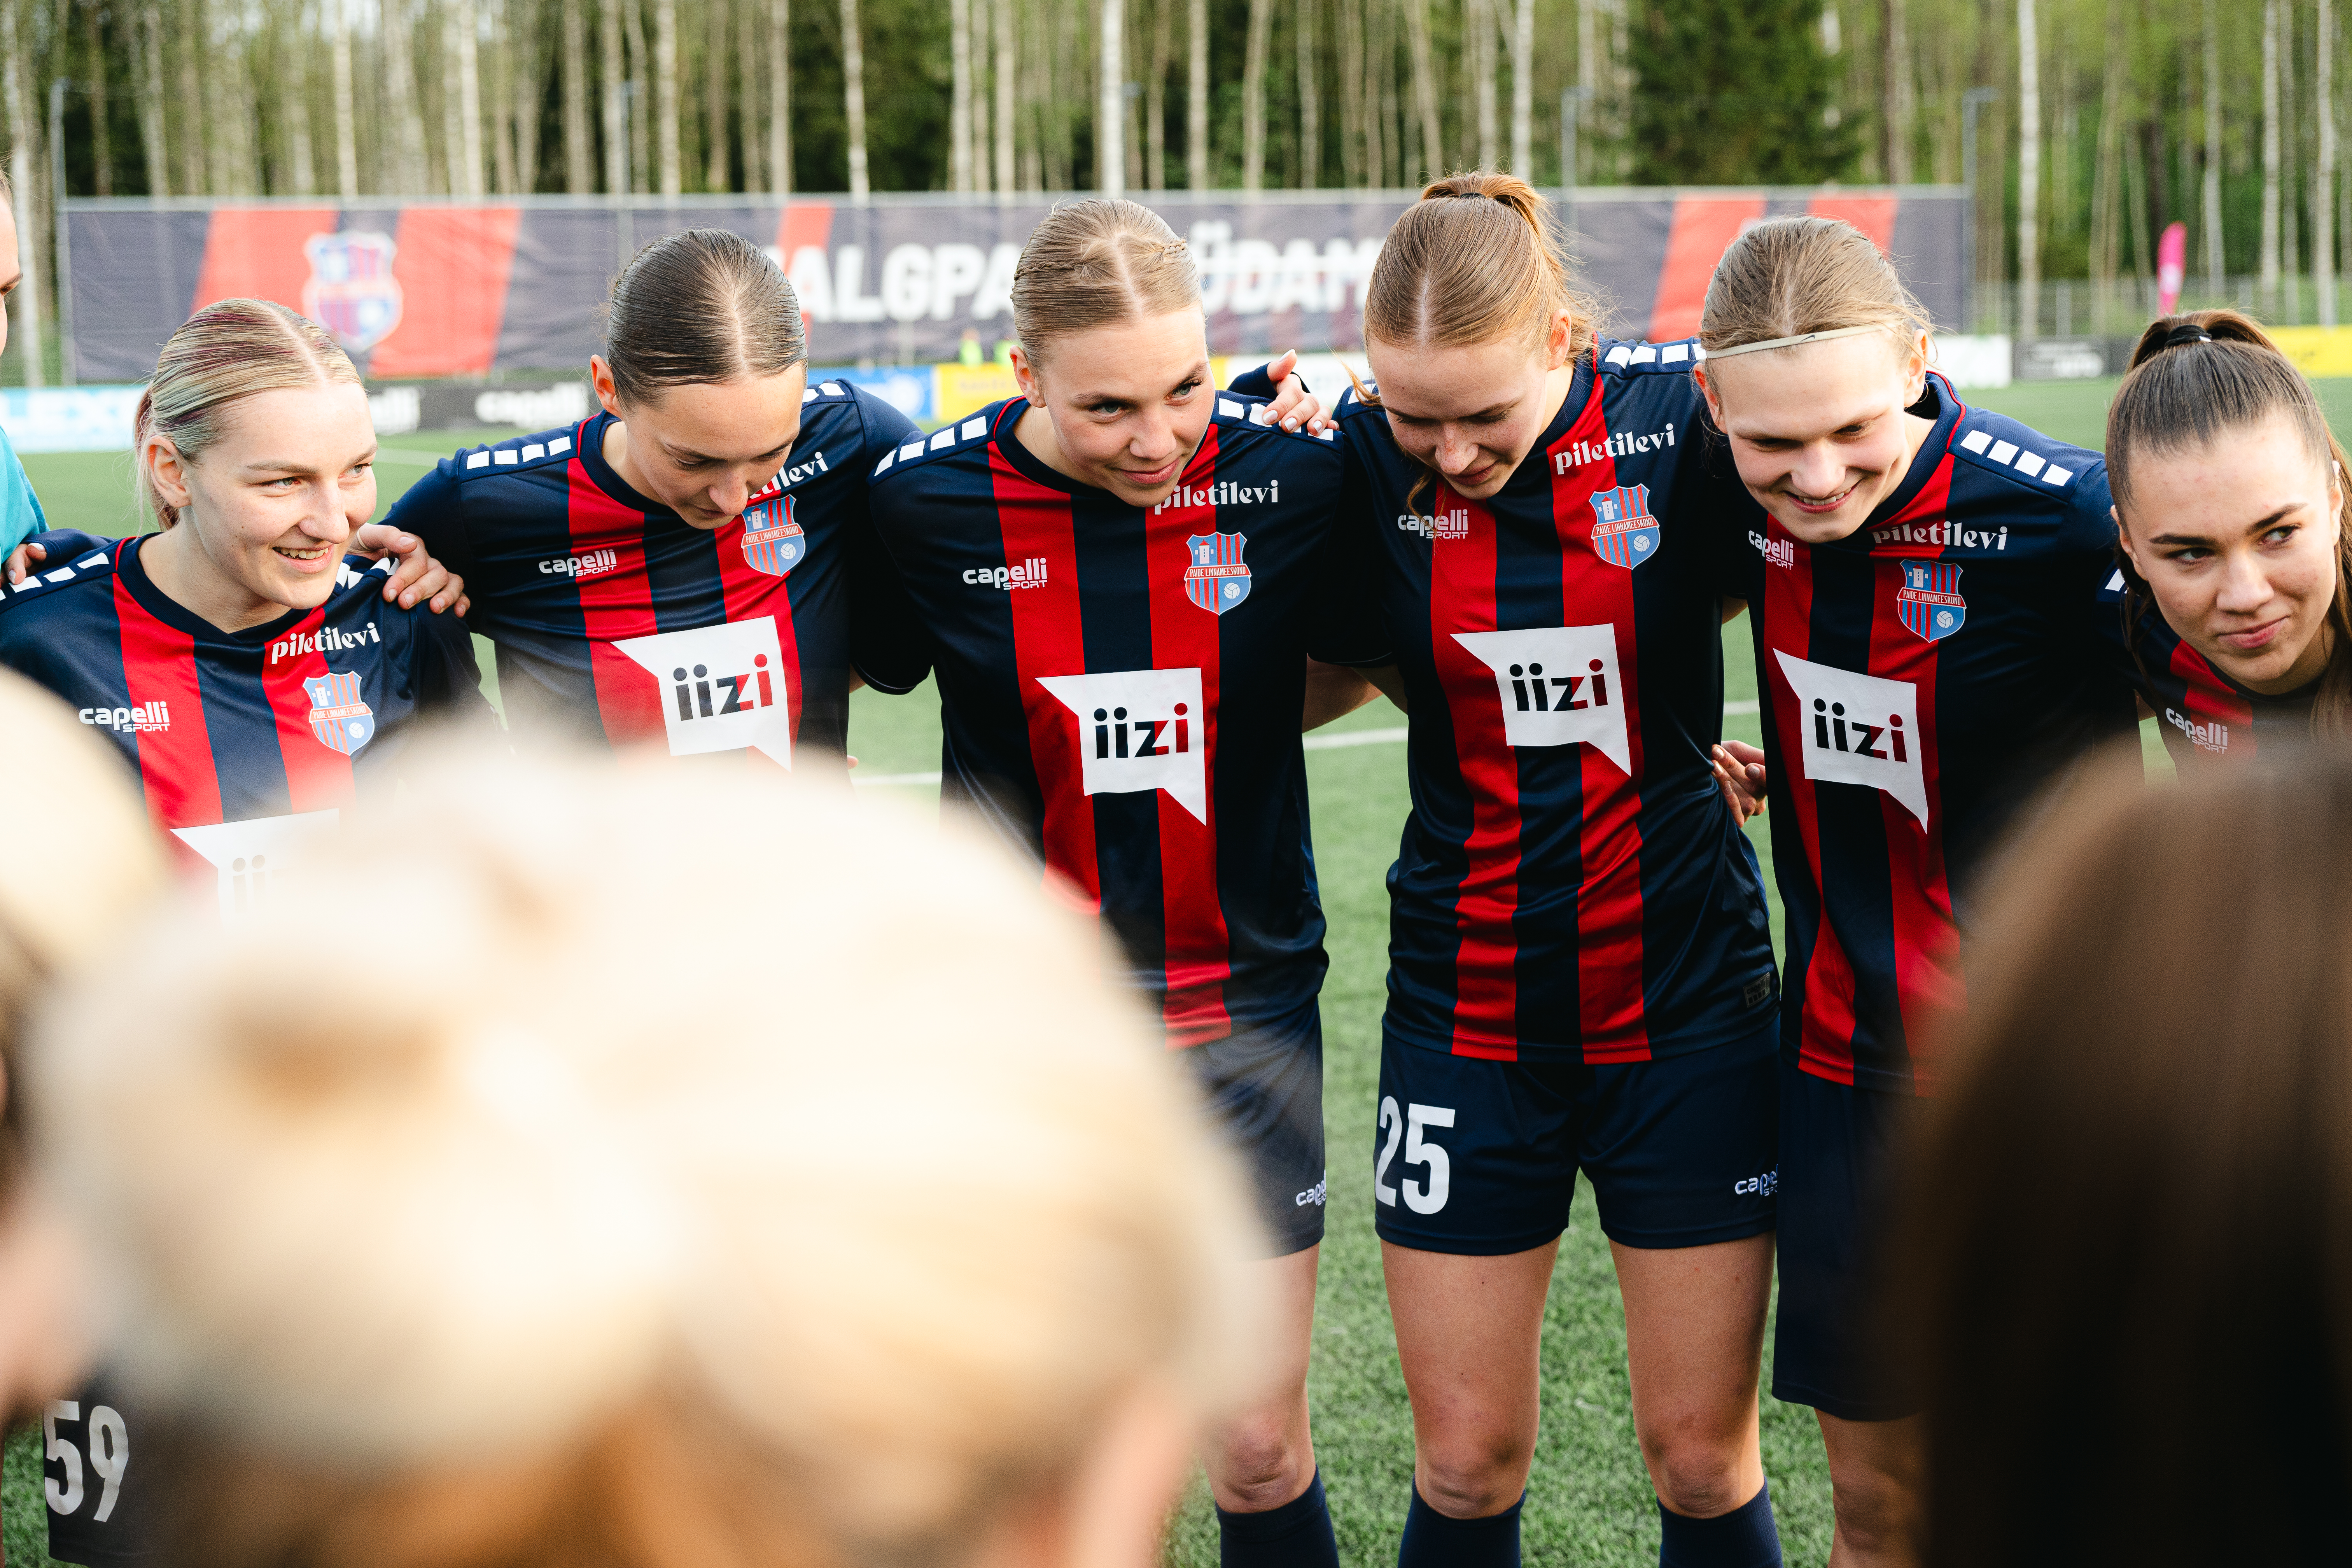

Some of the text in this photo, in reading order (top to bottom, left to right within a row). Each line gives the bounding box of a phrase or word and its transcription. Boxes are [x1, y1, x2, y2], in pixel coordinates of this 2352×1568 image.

[1555, 423, 1675, 475] piletilevi
[1155, 480, 1278, 515] piletilevi
[746, 525, 798, 544] PAIDE LINNAMEESKOND
[1398, 509, 1468, 536] capelli
[1596, 517, 1653, 535] PAIDE LINNAMEESKOND
[1871, 521, 2007, 550] piletilevi
[1748, 530, 1793, 563] capelli
[539, 549, 617, 576] capelli
[576, 564, 617, 577] SPORT
[963, 558, 1047, 588] capelli
[1190, 566, 1246, 577] PAIDE LINNAMEESKOND
[1766, 554, 1793, 570] SPORT
[1003, 580, 1048, 590] SPORT
[1903, 590, 1961, 605] PAIDE LINNAMEESKOND
[271, 622, 380, 664] piletilevi
[673, 654, 773, 721] iizi
[1509, 658, 1608, 712] iizi
[79, 701, 170, 731] capelli
[313, 705, 366, 719] PAIDE LINNAMEESKOND
[2166, 708, 2228, 746] capelli
[123, 723, 170, 733] SPORT
[1094, 703, 1189, 759] iizi
[1813, 698, 1908, 763] iizi
[2192, 736, 2228, 754] SPORT
[1374, 1095, 1456, 1216] 25
[1296, 1169, 1326, 1206] cape
[1735, 1164, 1778, 1195] cape
[43, 1400, 129, 1523] 59
